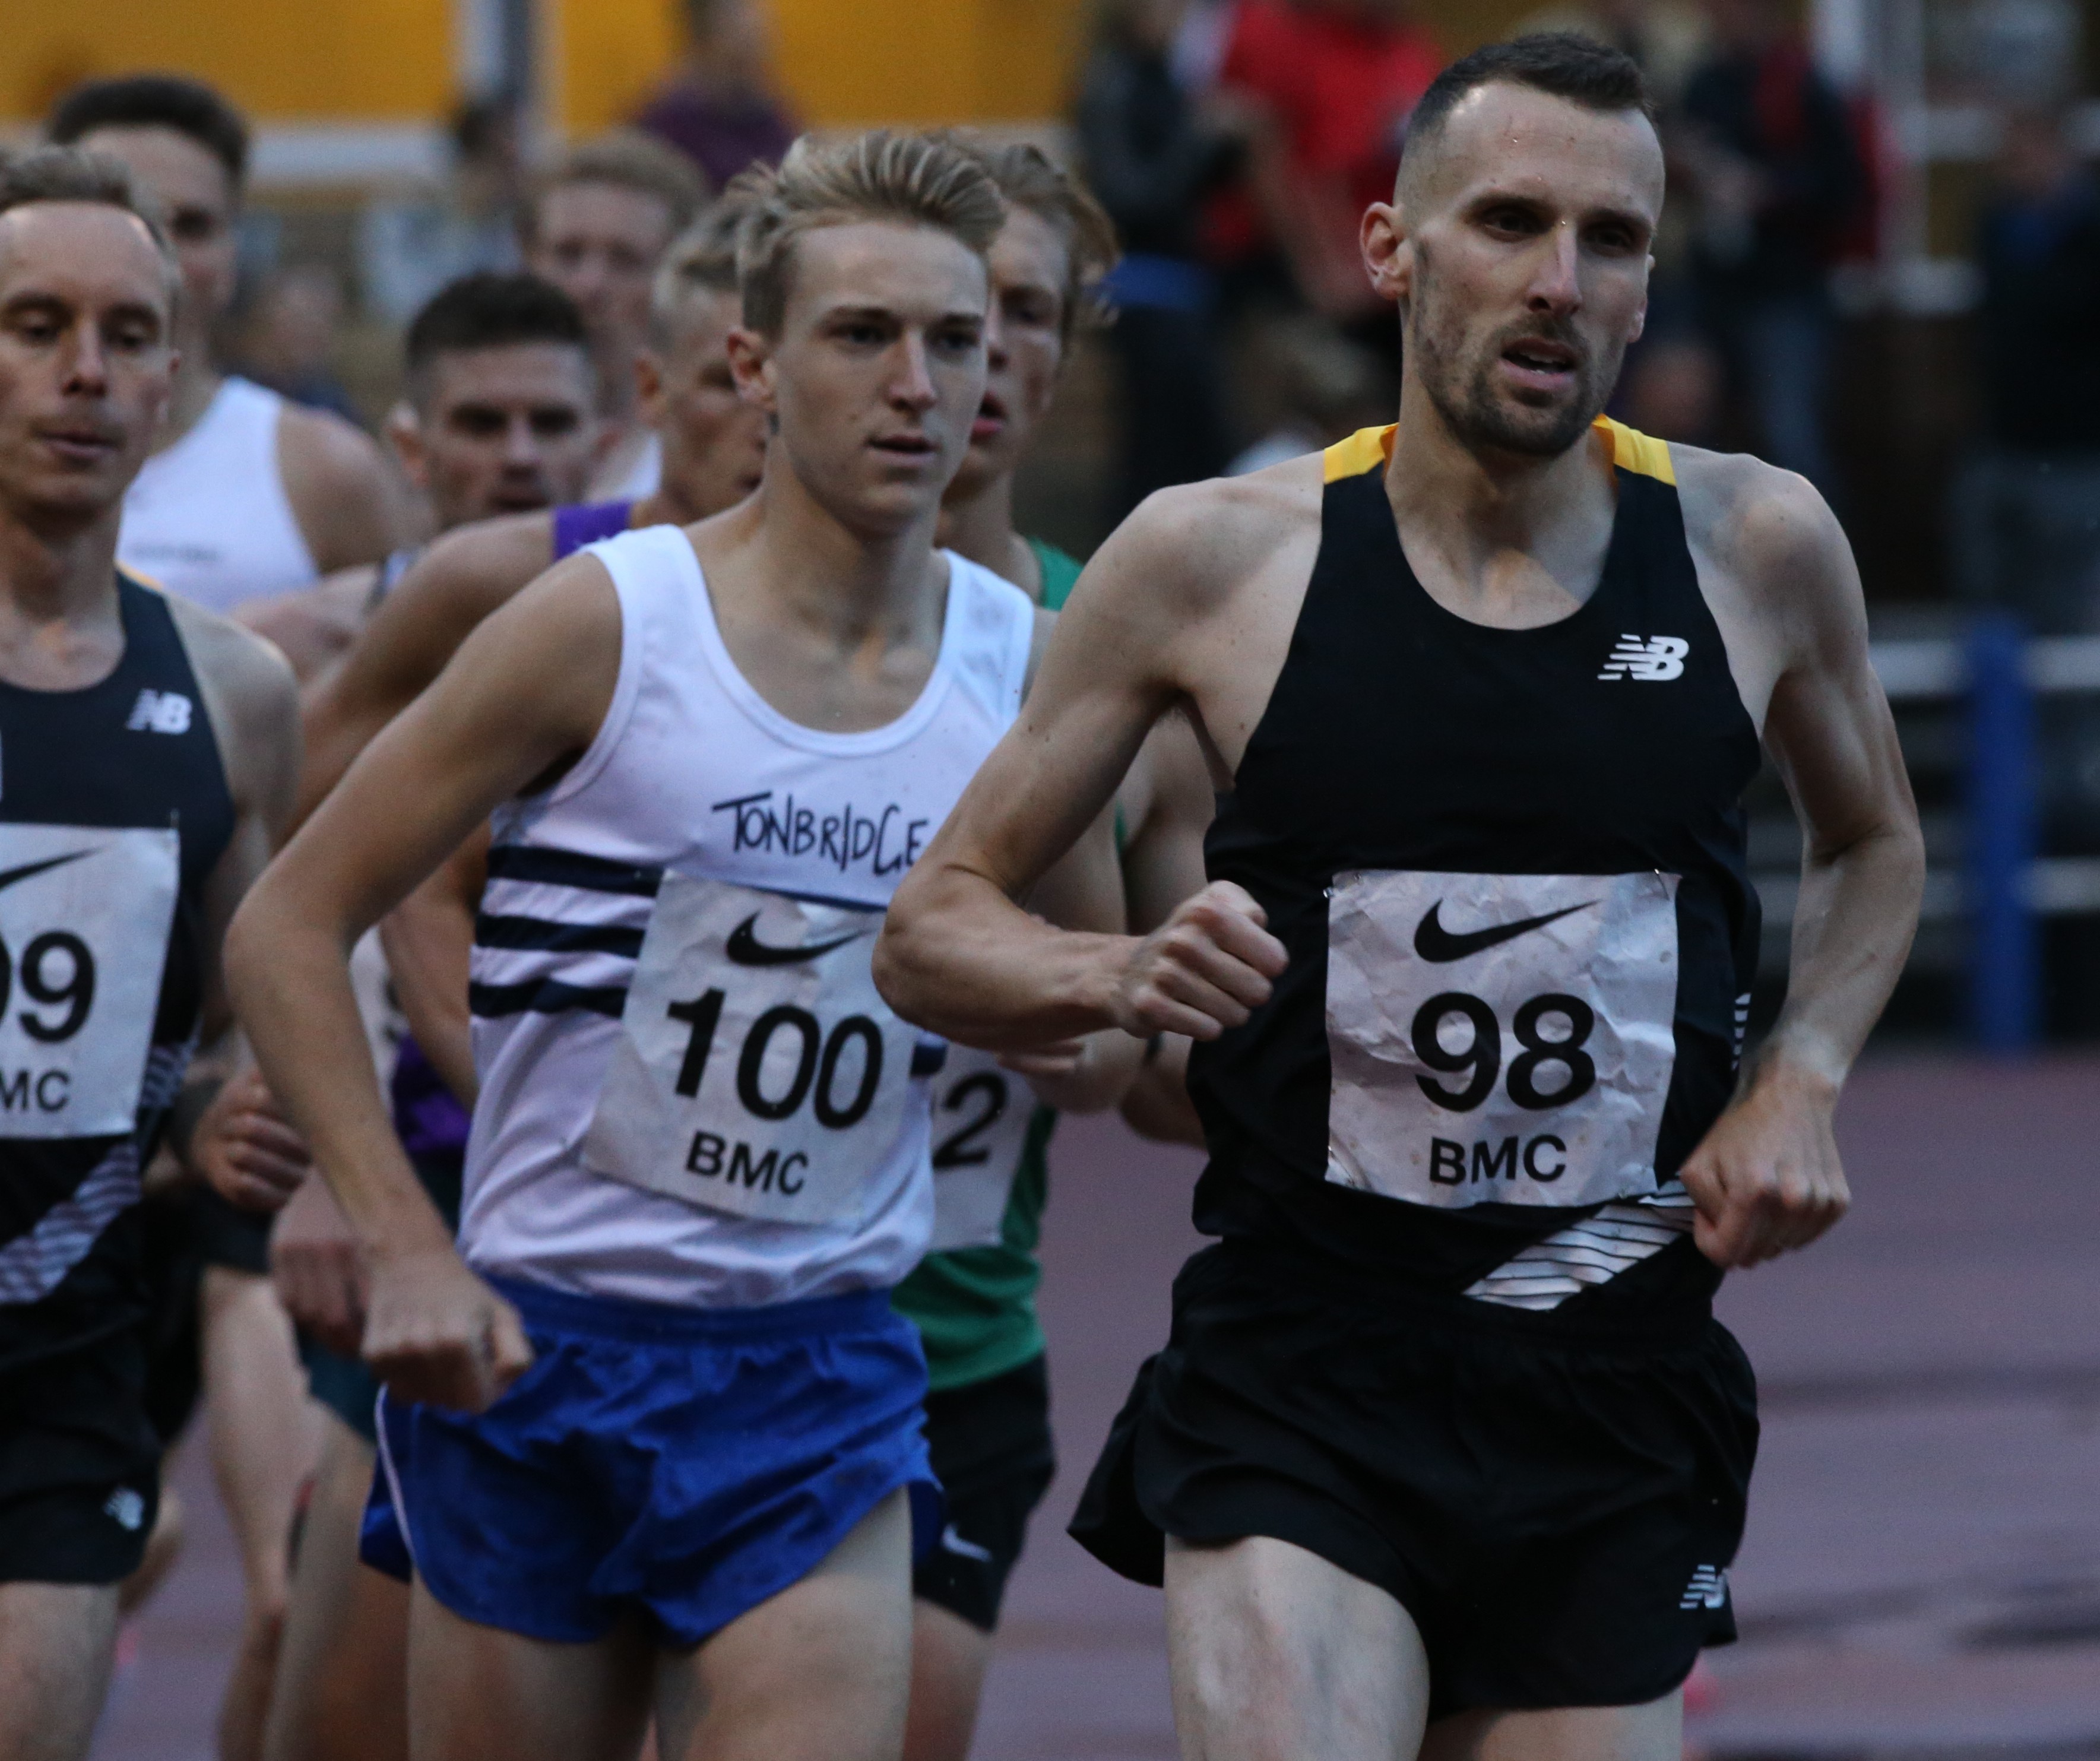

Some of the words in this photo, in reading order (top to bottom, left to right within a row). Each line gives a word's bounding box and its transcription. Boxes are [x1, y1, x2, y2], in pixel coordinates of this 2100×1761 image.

[711, 791, 929, 876] TONBRIDGE
[0, 930, 96, 1044] 9
[667, 987, 883, 1130] 100
[1411, 992, 1597, 1113] 98
[686, 1130, 809, 1196] BMC
[1429, 1133, 1566, 1186] BMC
